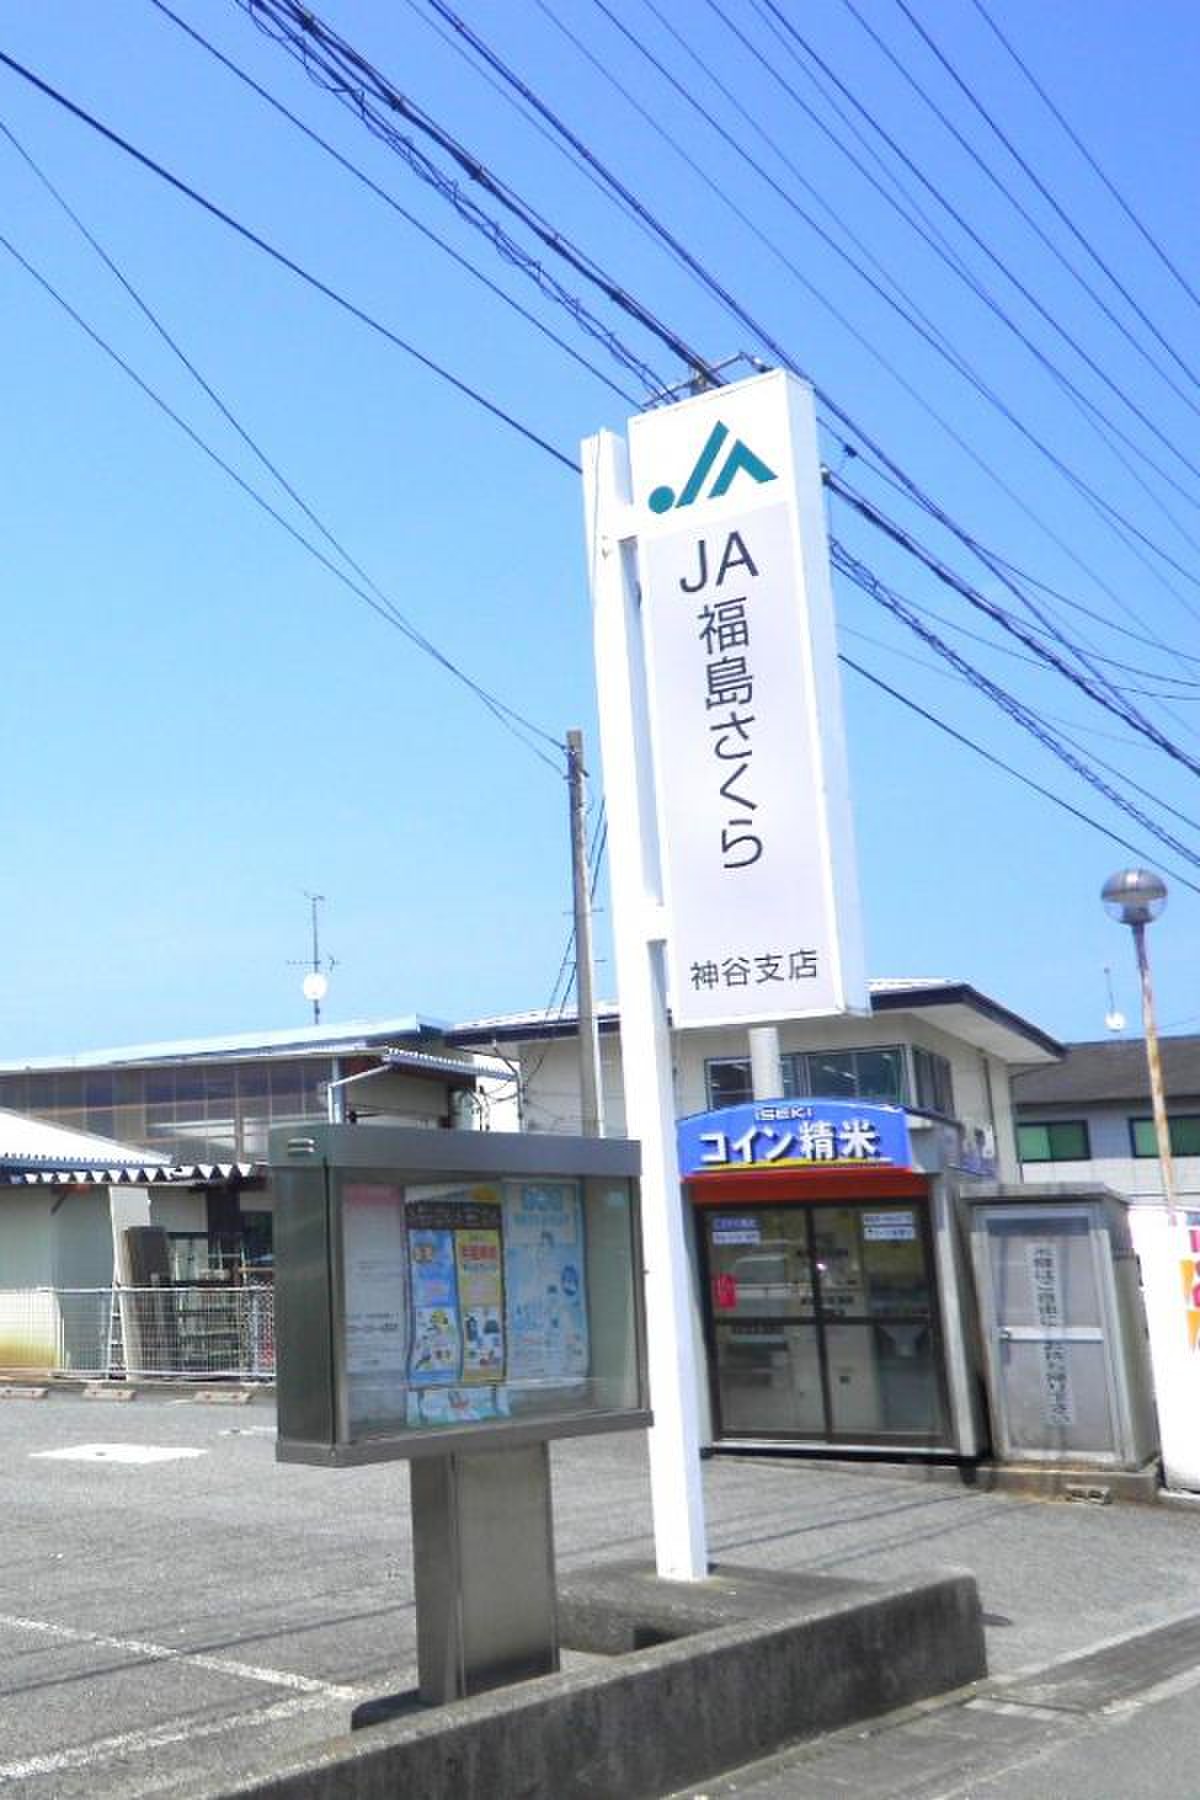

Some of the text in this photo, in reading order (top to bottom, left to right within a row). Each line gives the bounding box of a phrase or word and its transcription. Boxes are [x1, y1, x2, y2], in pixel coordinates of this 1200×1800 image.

[680, 530, 764, 870] JA福島さくら
[690, 949, 818, 990] 神谷支店
[701, 1119, 876, 1163] コイン精米
